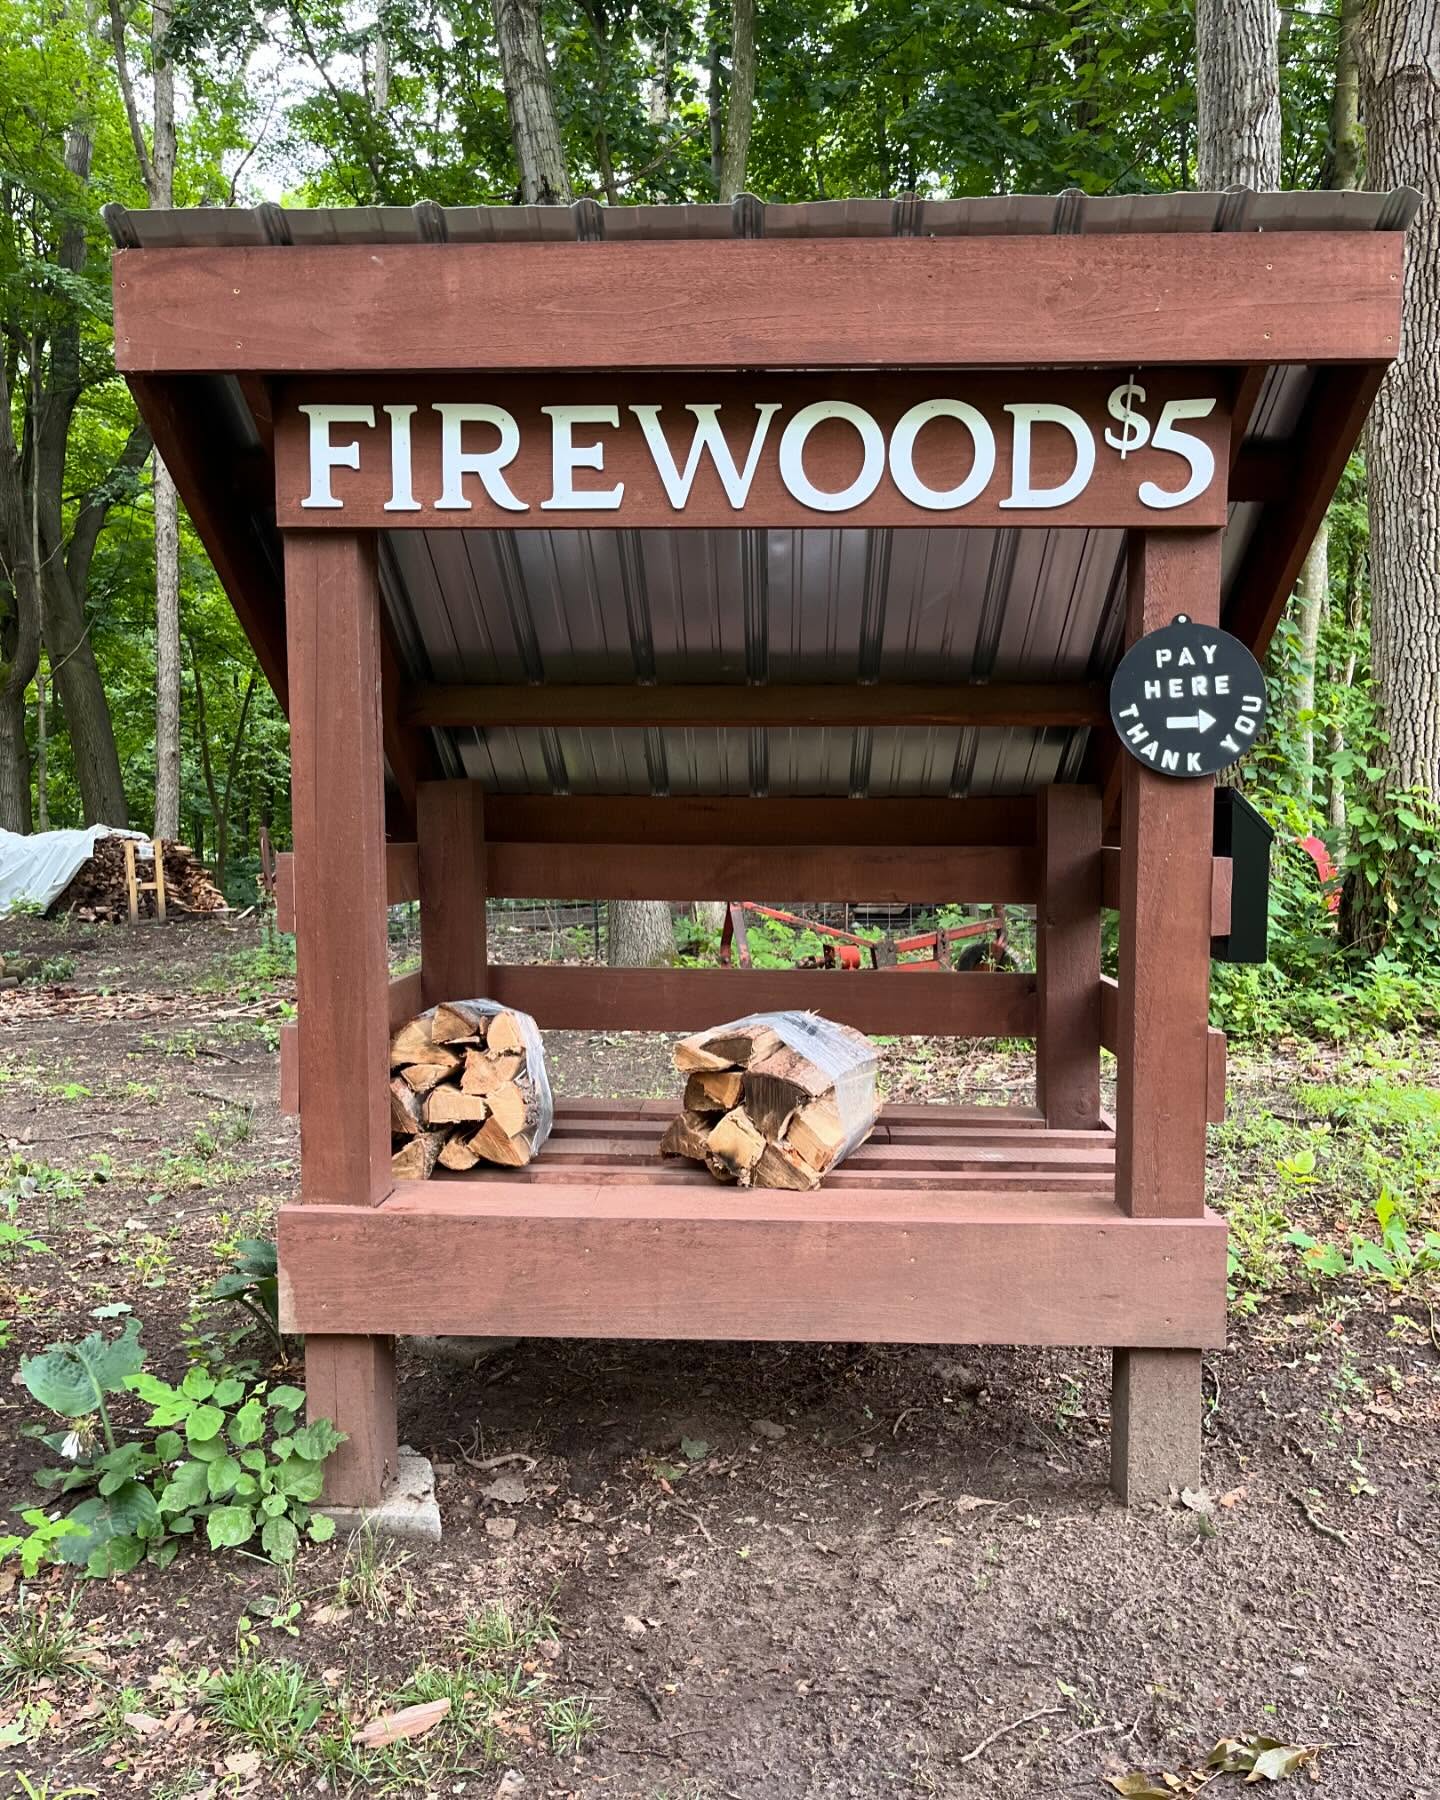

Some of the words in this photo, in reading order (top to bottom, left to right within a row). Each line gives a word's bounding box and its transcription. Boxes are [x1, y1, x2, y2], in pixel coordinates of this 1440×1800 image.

[298, 398, 1097, 512] FIREWOOD
[1104, 373, 1217, 509] $5
[1155, 644, 1218, 669] PAY
[1143, 674, 1231, 700] HERE
[1118, 702, 1203, 772] THANK
[1219, 695, 1263, 754] YOU
